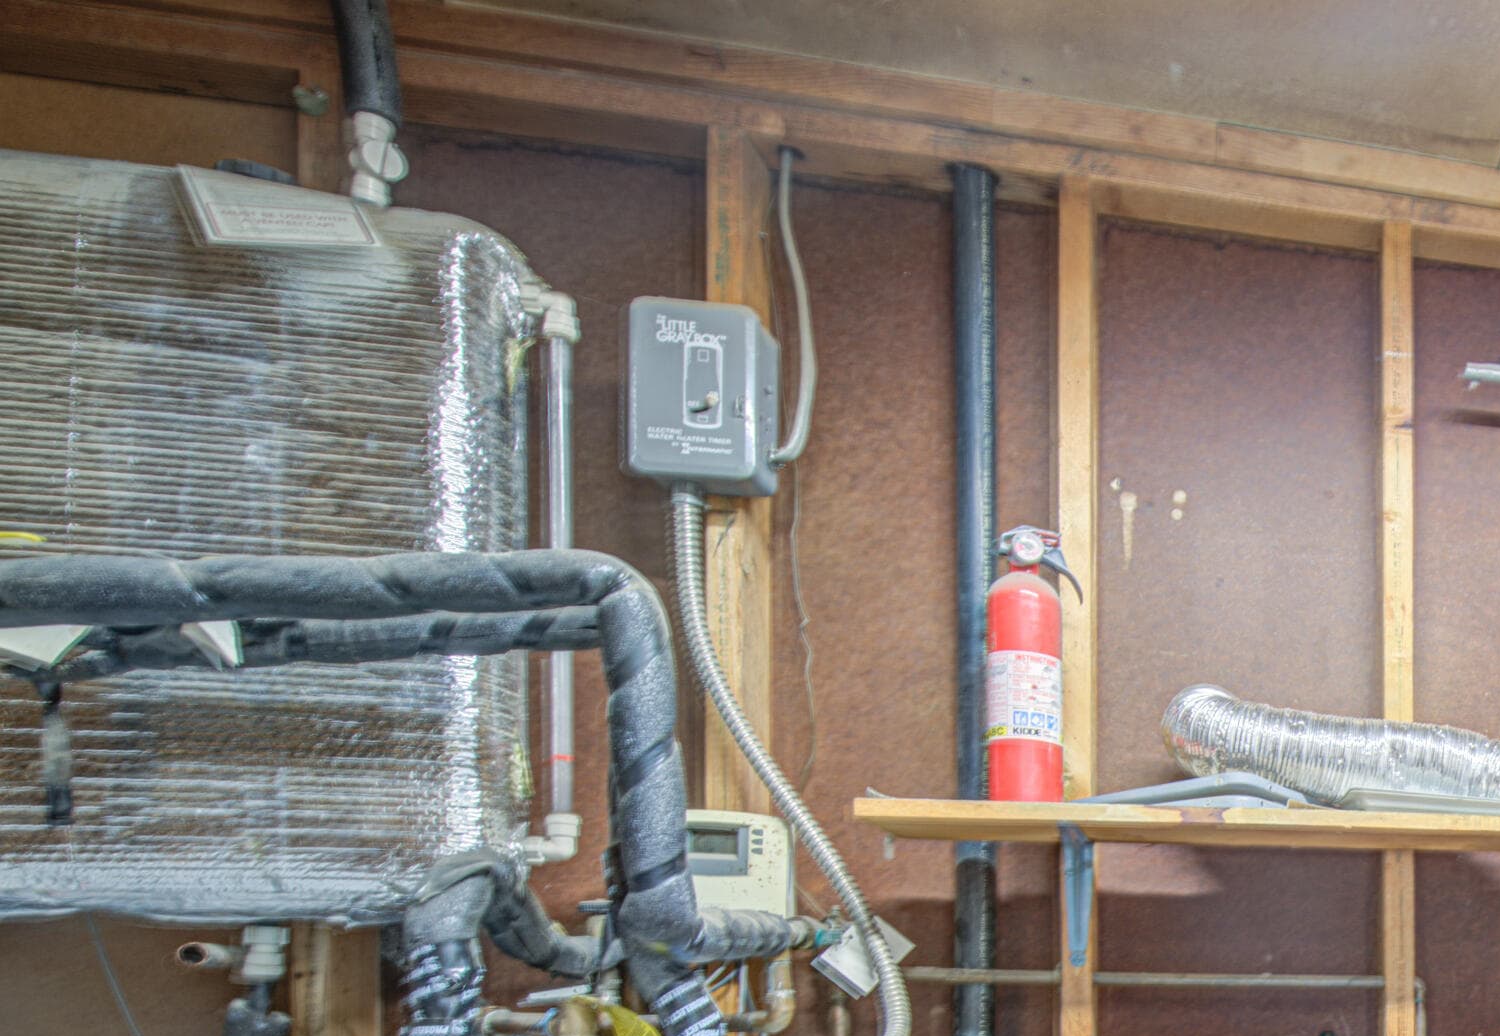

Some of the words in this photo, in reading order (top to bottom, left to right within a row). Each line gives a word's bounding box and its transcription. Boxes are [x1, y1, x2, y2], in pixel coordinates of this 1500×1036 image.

[647, 426, 683, 435] ELECTRIC
[647, 433, 674, 441] WATER
[1013, 727, 1042, 736] KIDDE
